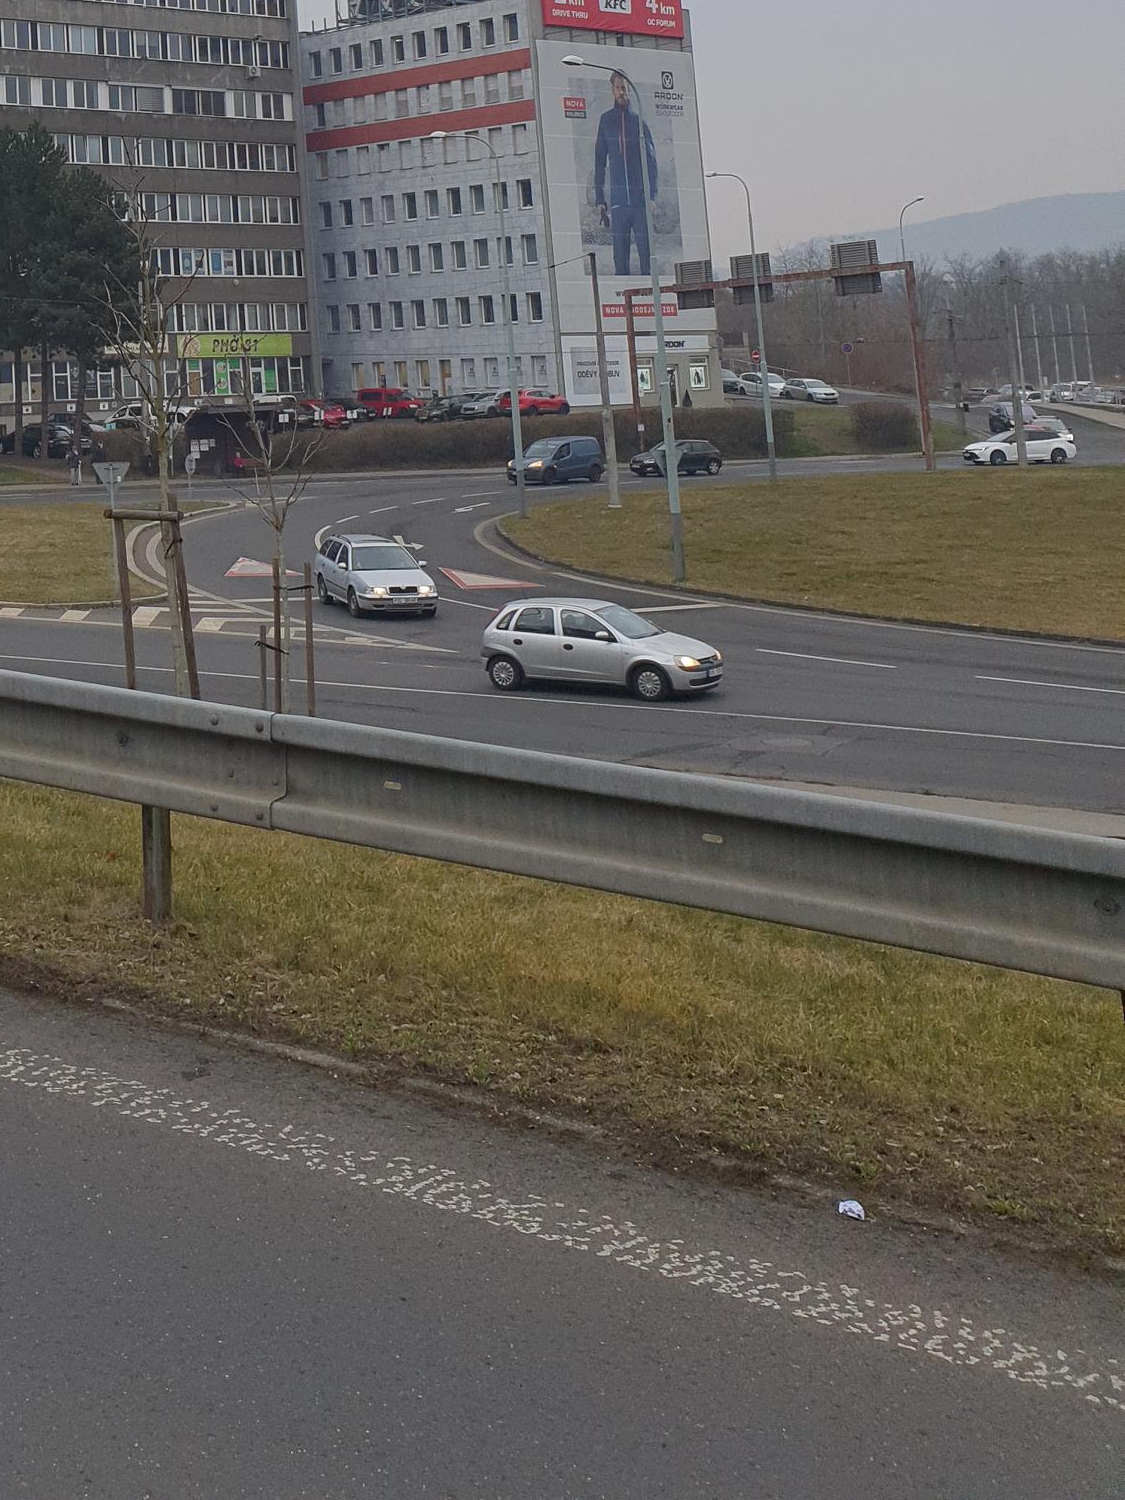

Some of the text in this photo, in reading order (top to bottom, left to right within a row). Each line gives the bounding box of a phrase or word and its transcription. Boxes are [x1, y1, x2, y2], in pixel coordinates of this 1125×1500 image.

[552, 9, 589, 20] DRIVE THRU
[660, 2, 676, 16] km
[663, 340, 685, 348] RDON
